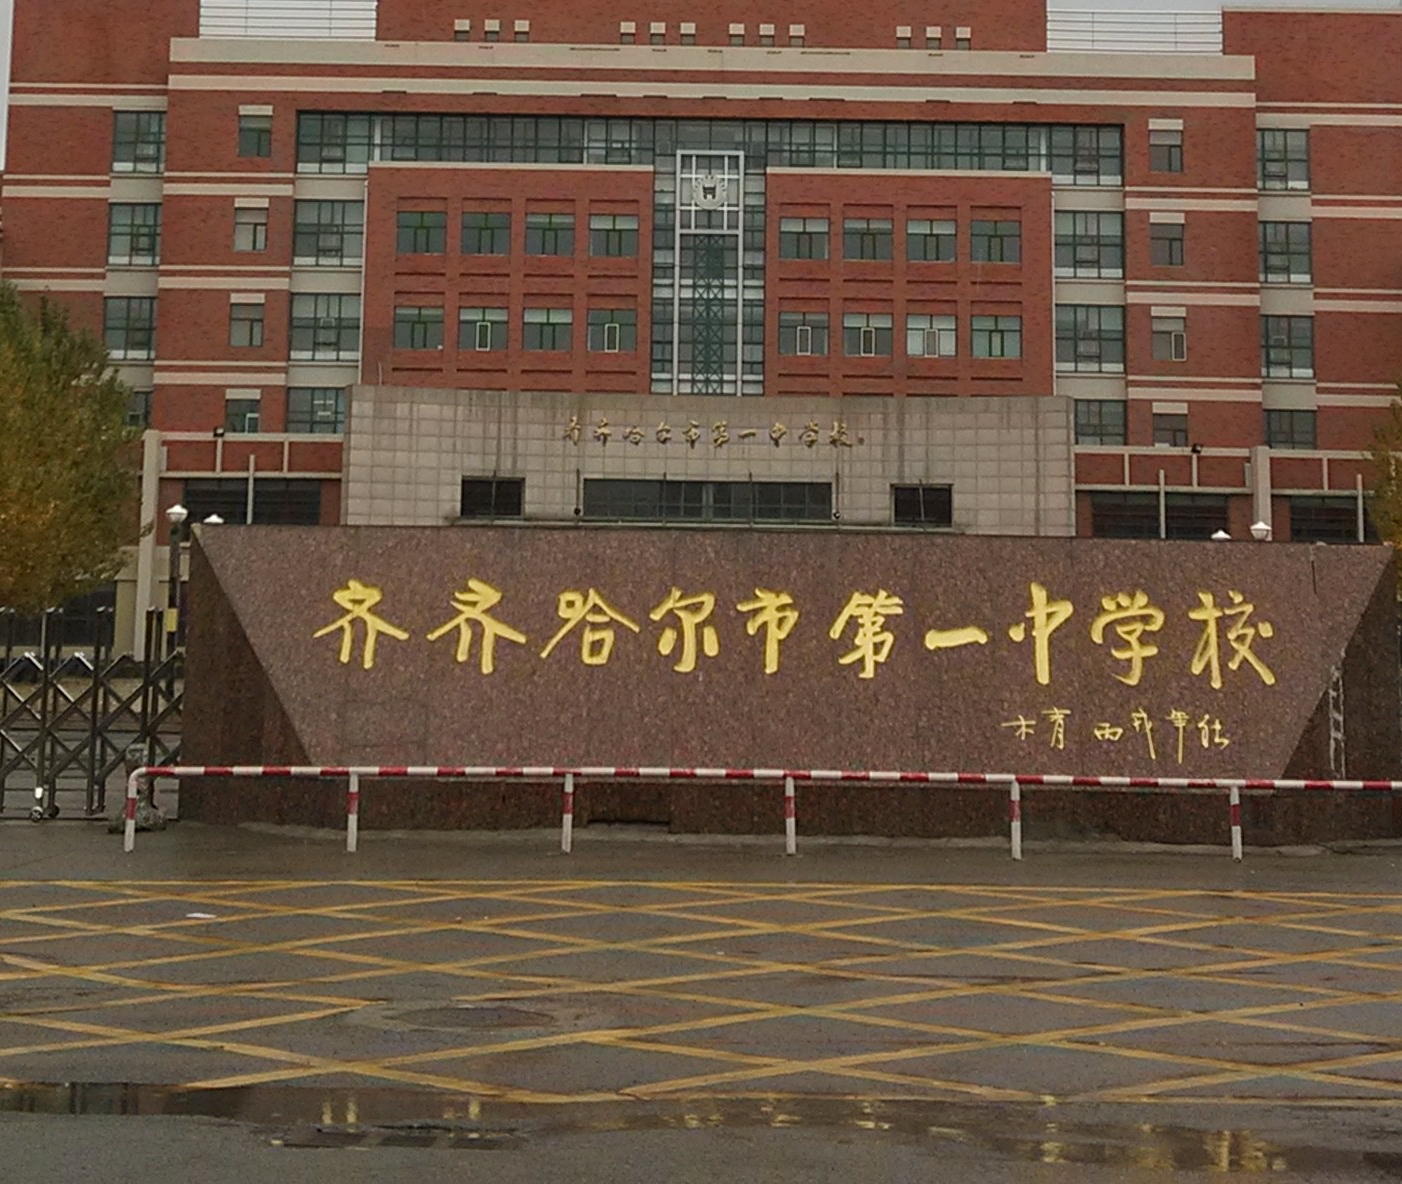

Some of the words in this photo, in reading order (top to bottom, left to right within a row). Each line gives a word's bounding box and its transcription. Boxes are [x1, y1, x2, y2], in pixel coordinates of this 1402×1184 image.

[314, 577, 1277, 689] 齐齐哈尔市第一中学校
